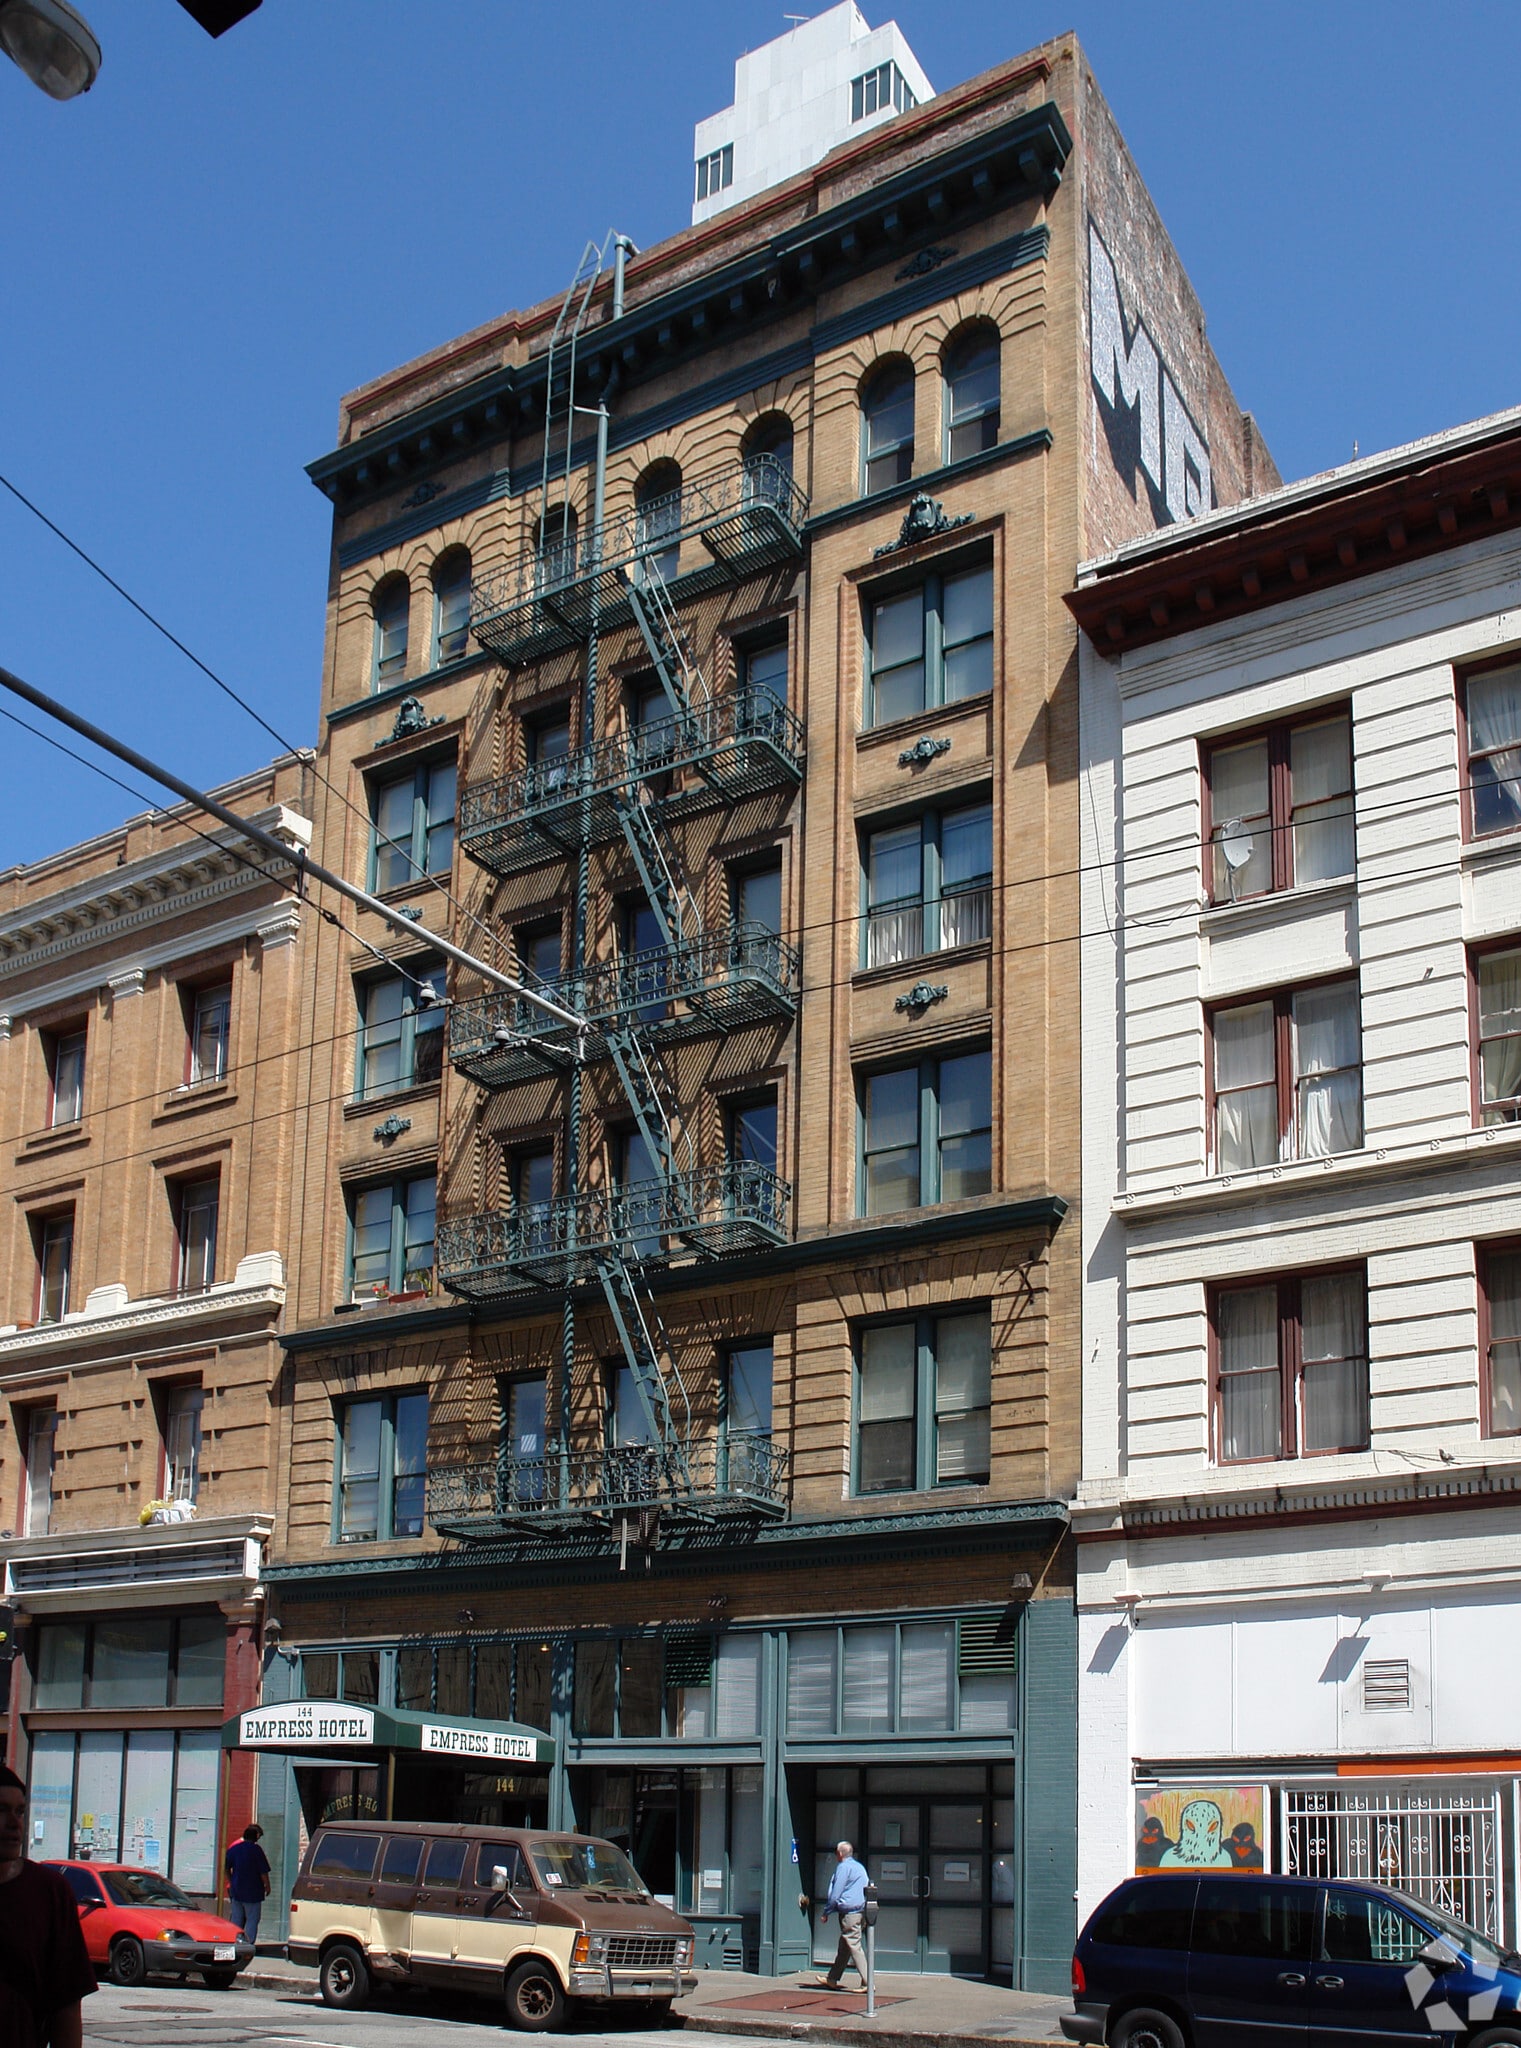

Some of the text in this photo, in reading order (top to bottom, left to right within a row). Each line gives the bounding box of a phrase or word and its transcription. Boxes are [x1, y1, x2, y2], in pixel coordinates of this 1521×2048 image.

[297, 1707, 313, 1717] 144
[245, 1719, 367, 1738] EMPRESS HOTEL
[430, 1729, 531, 1757] EMPRESS HOTEL
[496, 1777, 515, 1793] 144
